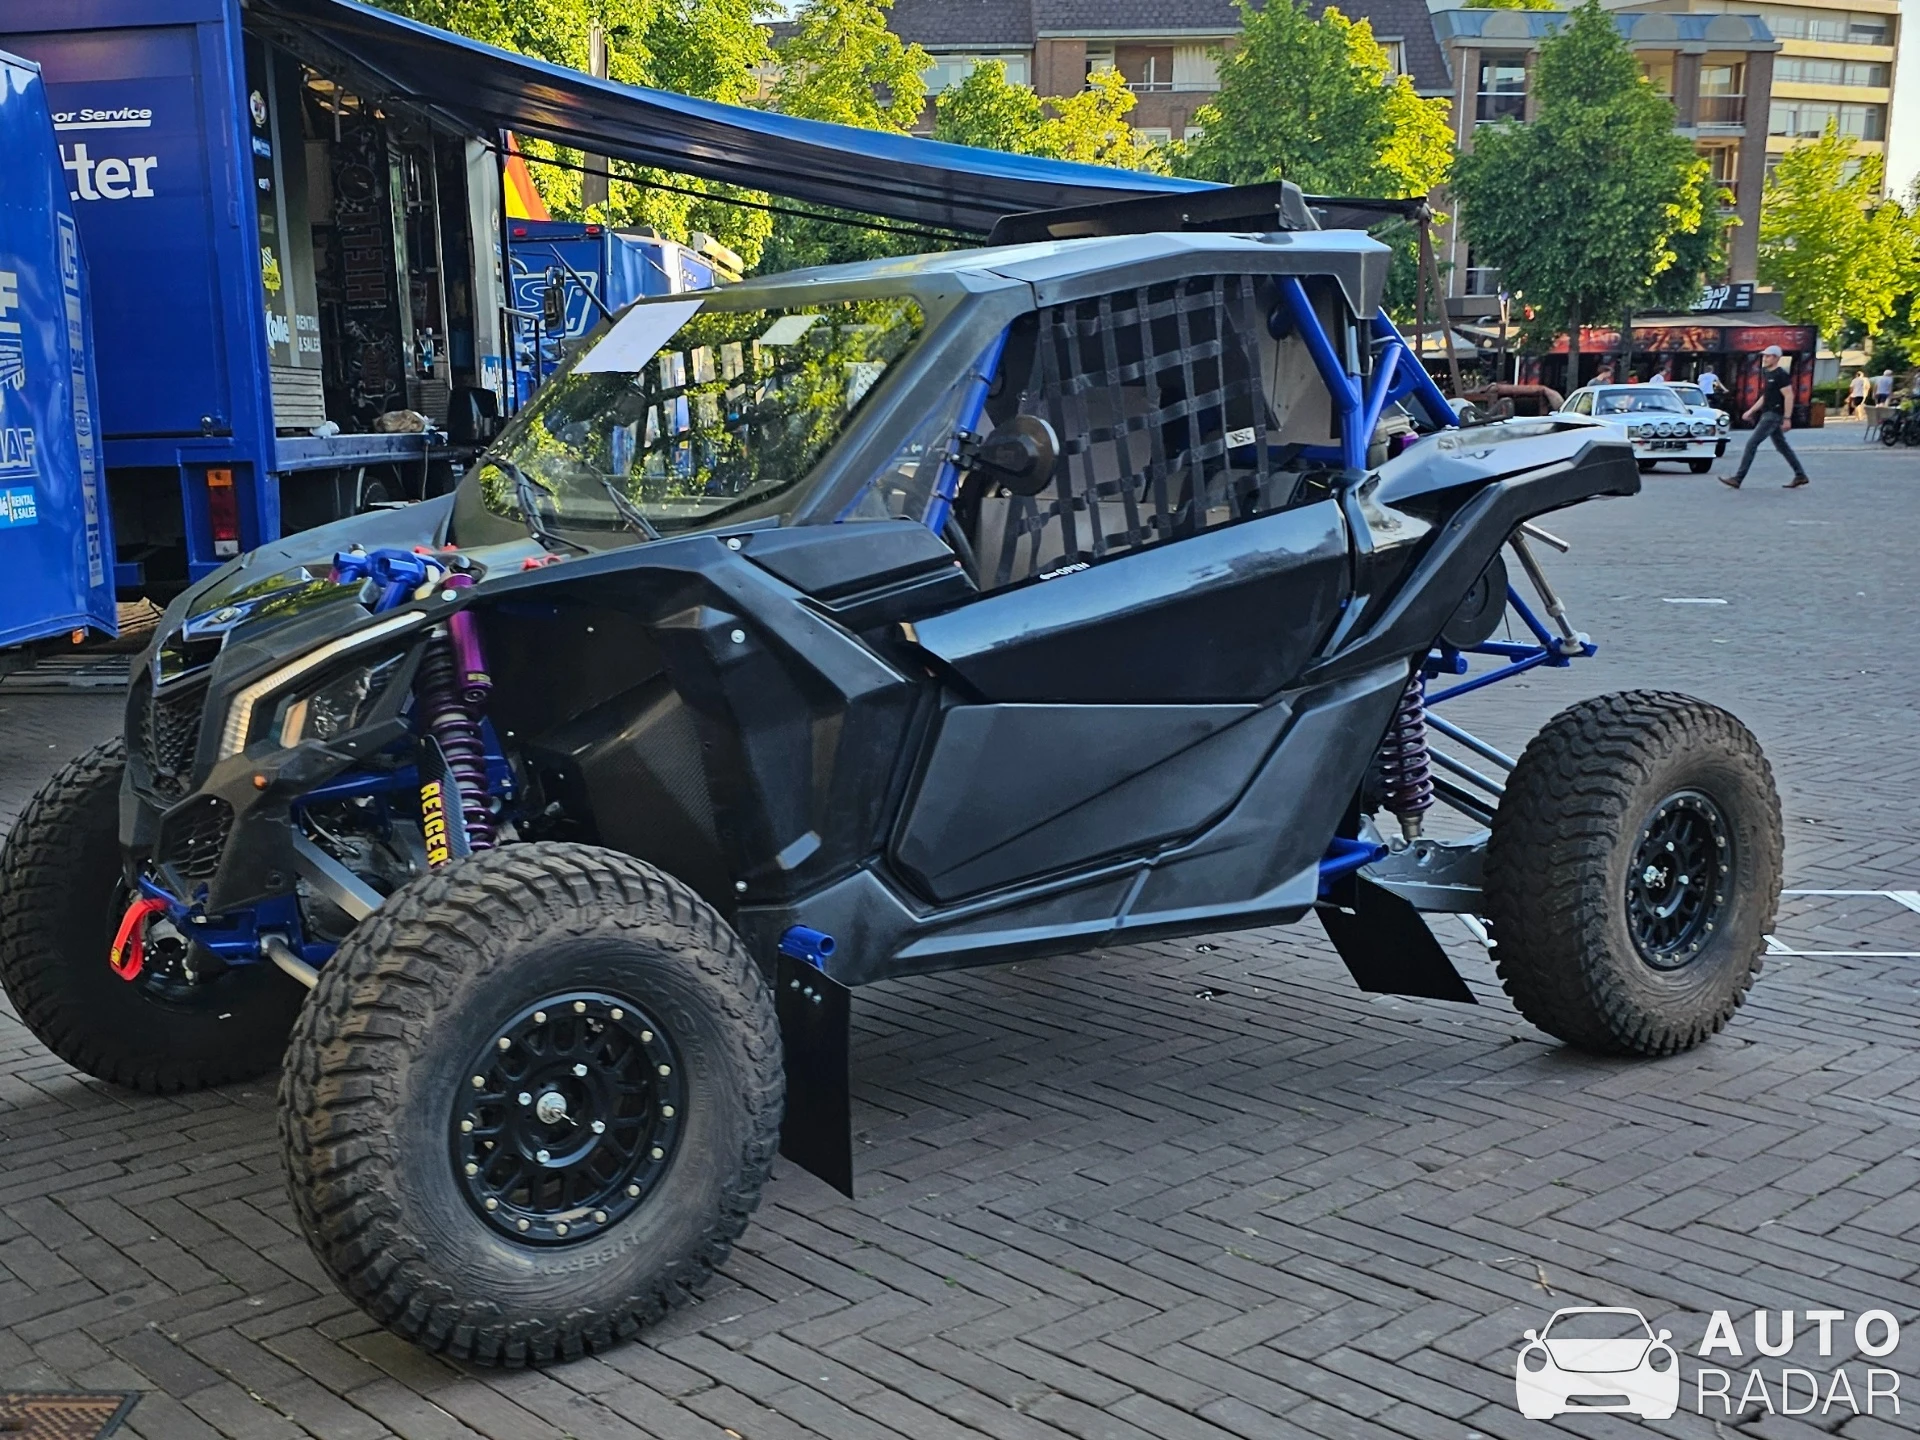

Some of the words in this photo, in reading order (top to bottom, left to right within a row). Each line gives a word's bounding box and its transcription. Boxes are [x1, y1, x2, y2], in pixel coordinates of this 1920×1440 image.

[52, 111, 76, 123] or
[79, 107, 152, 122] Service
[341, 206, 387, 301] HELL
[296, 314, 320, 332] RENTAL
[304, 337, 321, 352] SALES
[0, 428, 36, 468] AF
[11, 494, 36, 508] RENTAL
[18, 506, 37, 519] SALES
[1055, 562, 1091, 575] OPEN
[420, 782, 448, 866] REIGER
